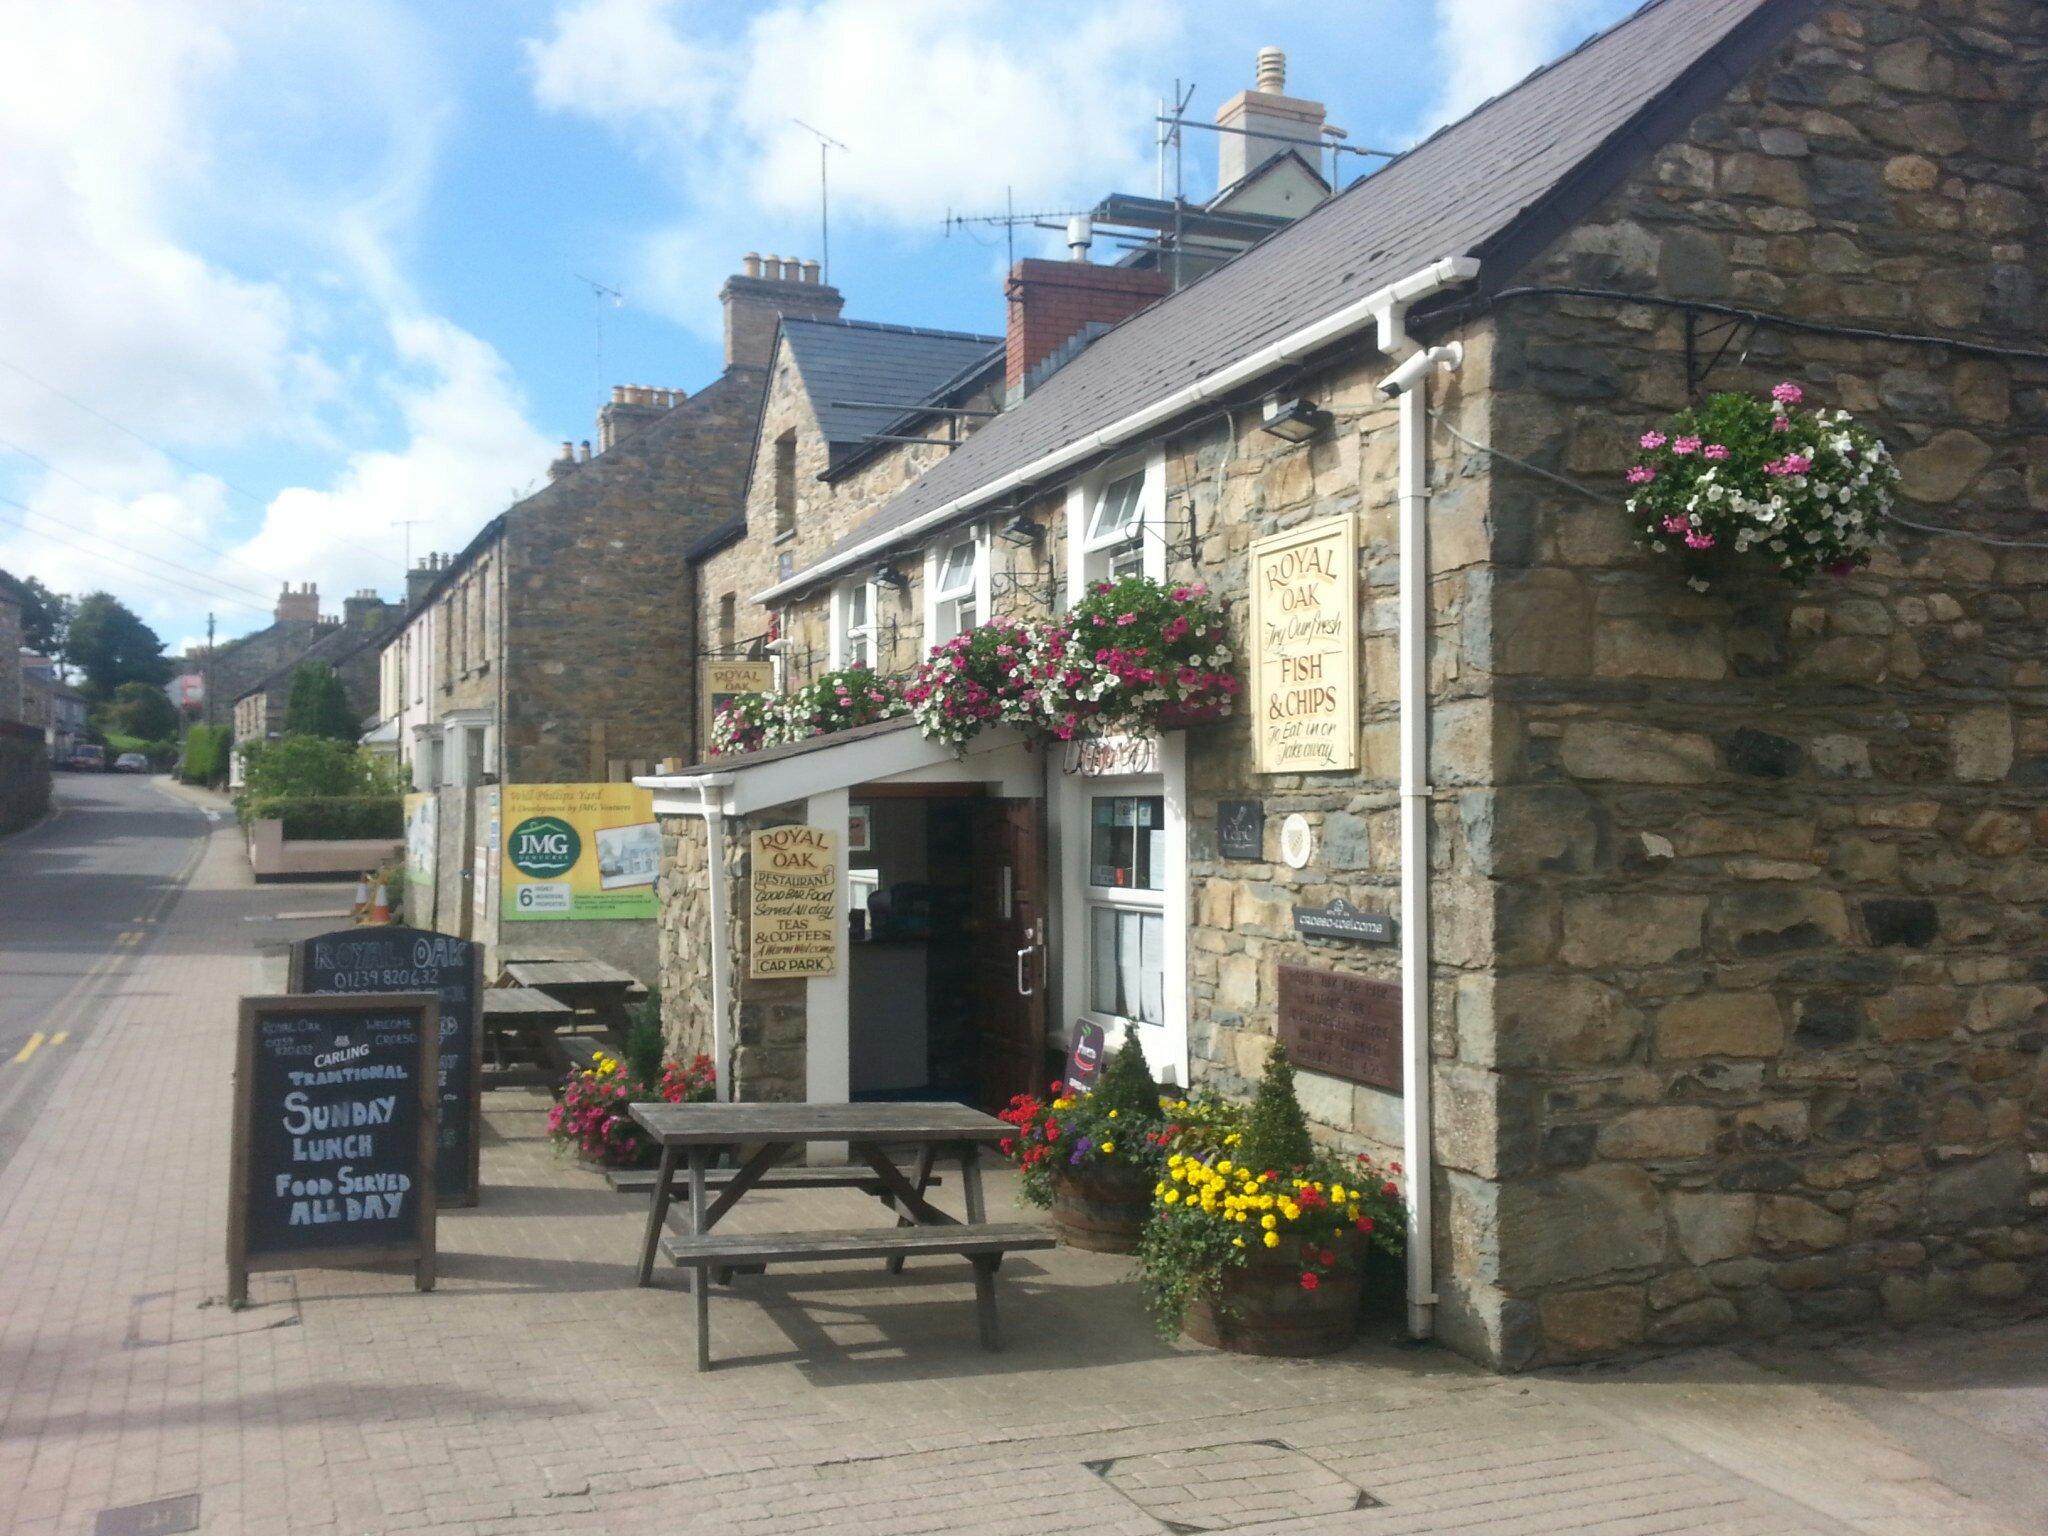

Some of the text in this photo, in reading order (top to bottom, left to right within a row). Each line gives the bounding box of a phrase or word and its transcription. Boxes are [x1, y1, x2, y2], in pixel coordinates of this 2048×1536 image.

[1265, 546, 1338, 592] ROYAL
[1281, 583, 1321, 613] OAK
[1266, 611, 1342, 650] Try Our fresh
[713, 668, 761, 683] ROYAL
[1281, 654, 1323, 683] FISH
[724, 682, 752, 691] OAK
[1282, 722, 1303, 740] Eat
[1305, 721, 1320, 737] in
[1320, 721, 1337, 736] or
[578, 788, 604, 801] Yard
[579, 803, 597, 813] JMG
[519, 834, 569, 855] JMG
[759, 829, 829, 851] ROYAL
[773, 852, 818, 869] OAK
[758, 873, 829, 887] RESTAURANT
[519, 888, 533, 907] 6
[785, 889, 805, 900] BAR
[754, 903, 834, 920] Served All day
[777, 919, 809, 931] TEAS
[314, 937, 468, 971] ROYAL OAK
[753, 945, 765, 959] A
[765, 945, 795, 956] Warm
[760, 957, 825, 972] CAR PARK
[334, 969, 440, 989] 01239 820632
[314, 1044, 370, 1068] CARLING
[283, 1091, 396, 1136] SUNDAY
[292, 1134, 373, 1162] LUNCH
[275, 1166, 411, 1198] FOOD SERVED
[288, 1192, 404, 1226] ALL DAY
